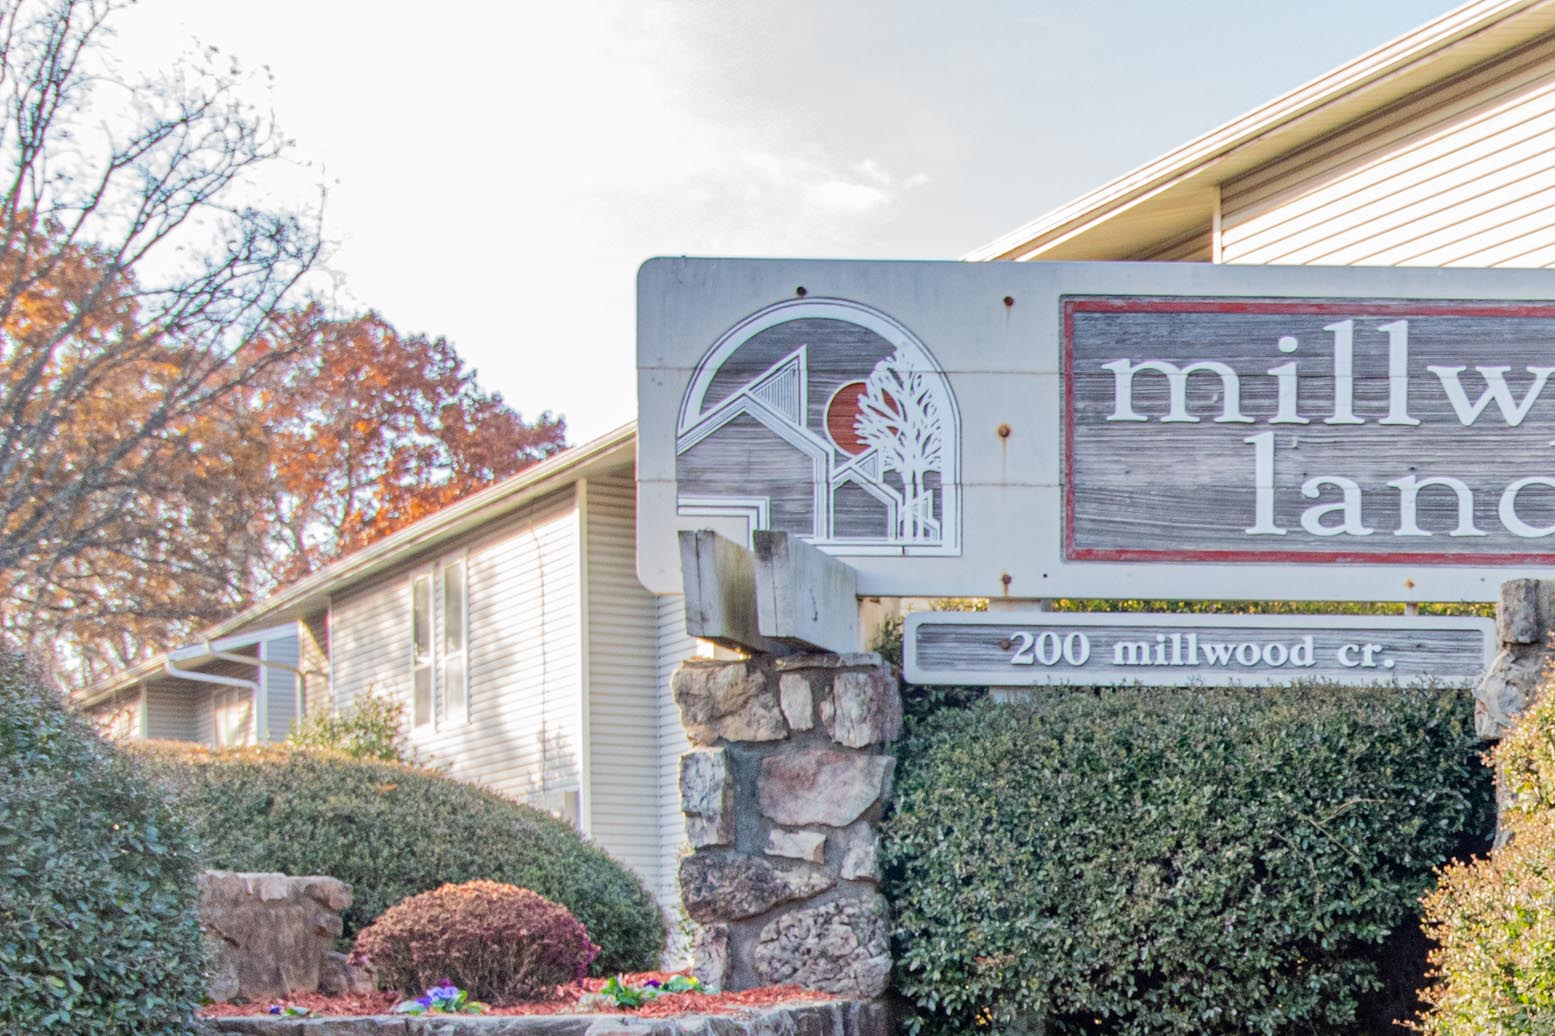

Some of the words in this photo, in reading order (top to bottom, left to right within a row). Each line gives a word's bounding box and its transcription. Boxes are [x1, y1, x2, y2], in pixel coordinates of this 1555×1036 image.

[1009, 631, 1090, 667] 200
[1112, 633, 1316, 668] millwood
[1337, 640, 1396, 669] cr.
